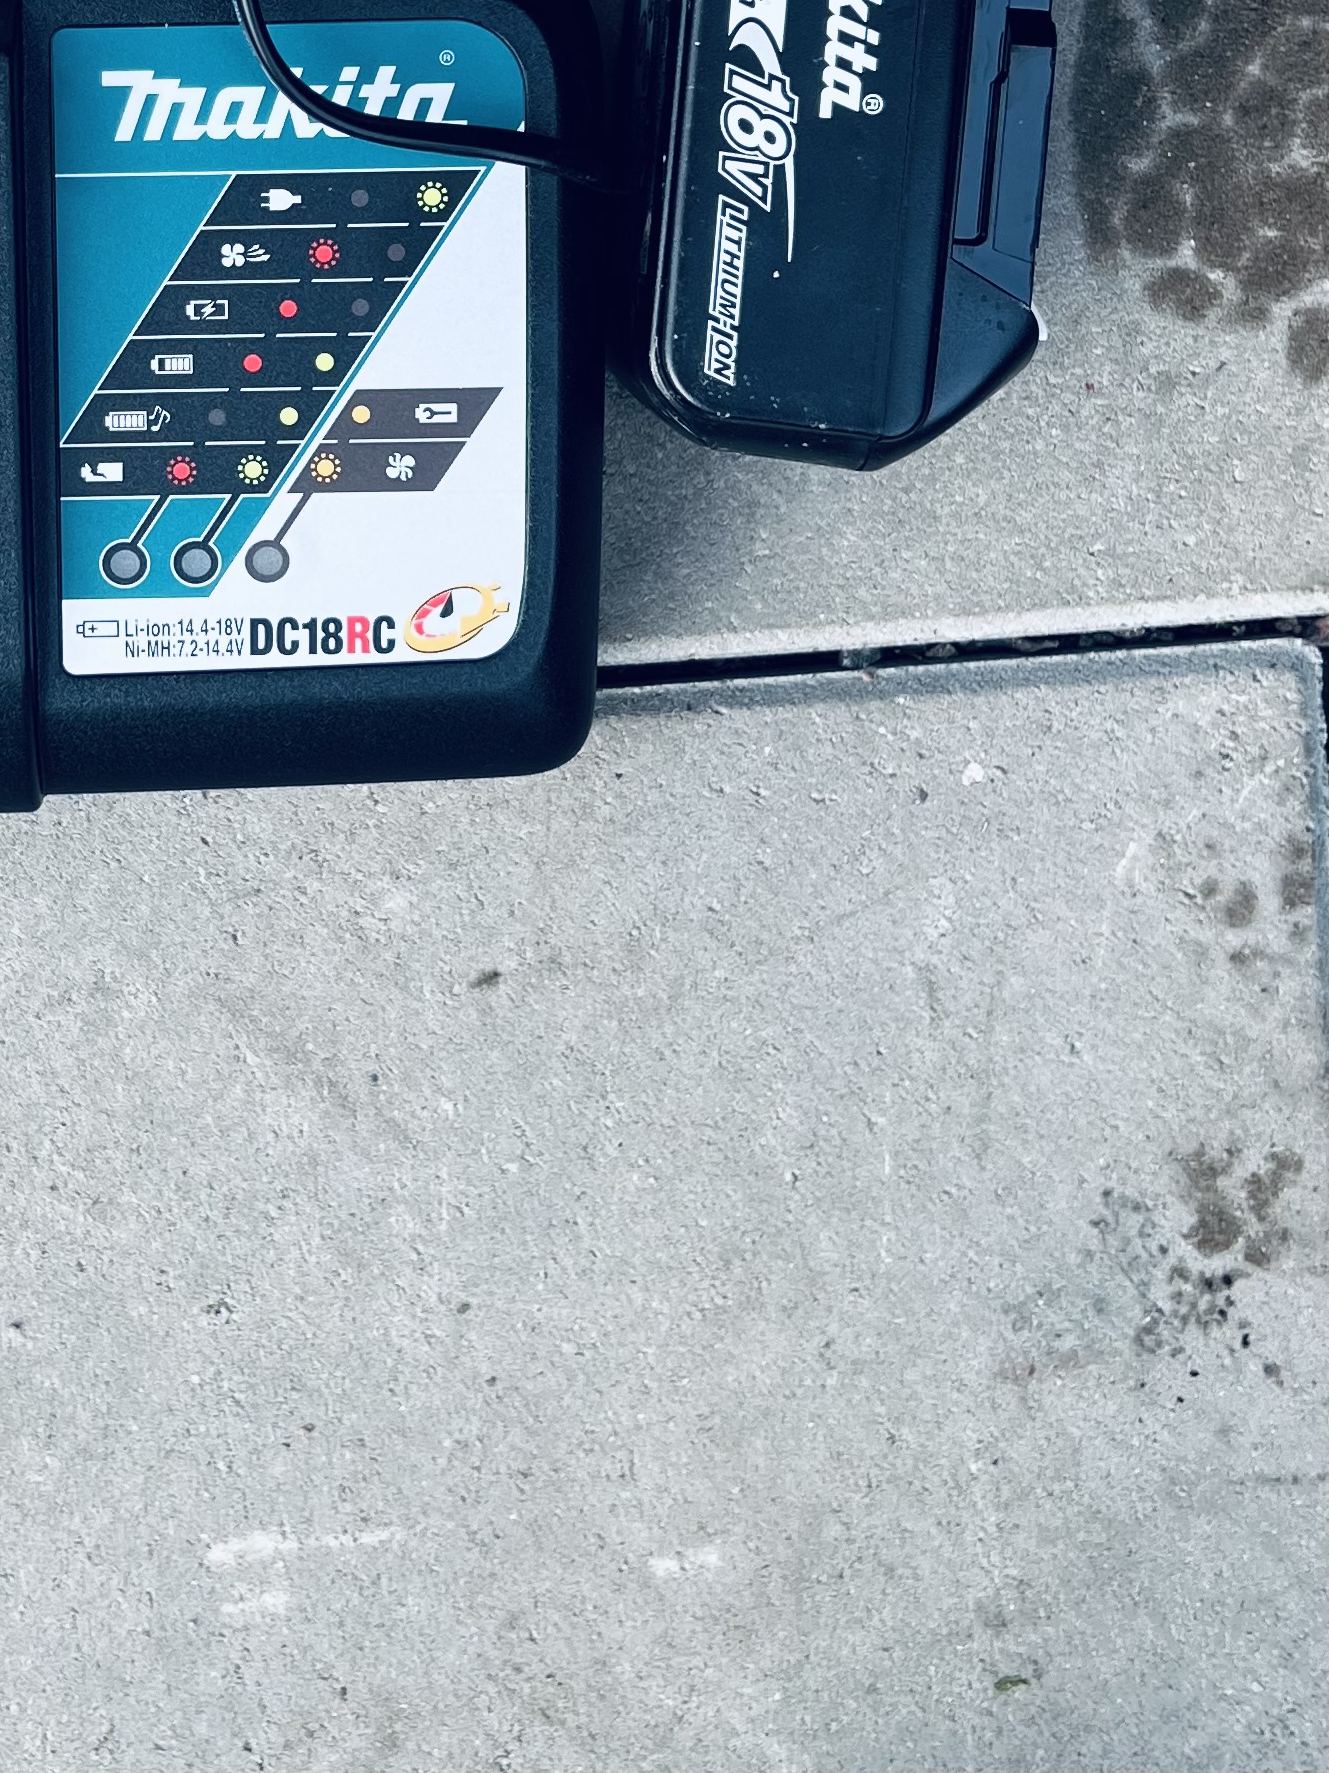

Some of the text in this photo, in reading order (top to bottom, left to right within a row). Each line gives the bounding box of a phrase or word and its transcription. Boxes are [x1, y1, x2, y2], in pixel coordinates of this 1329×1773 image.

[718, 63, 799, 212] 18V
[704, 194, 749, 387] LITHIUM-ION
[249, 615, 397, 656] DC18RC
